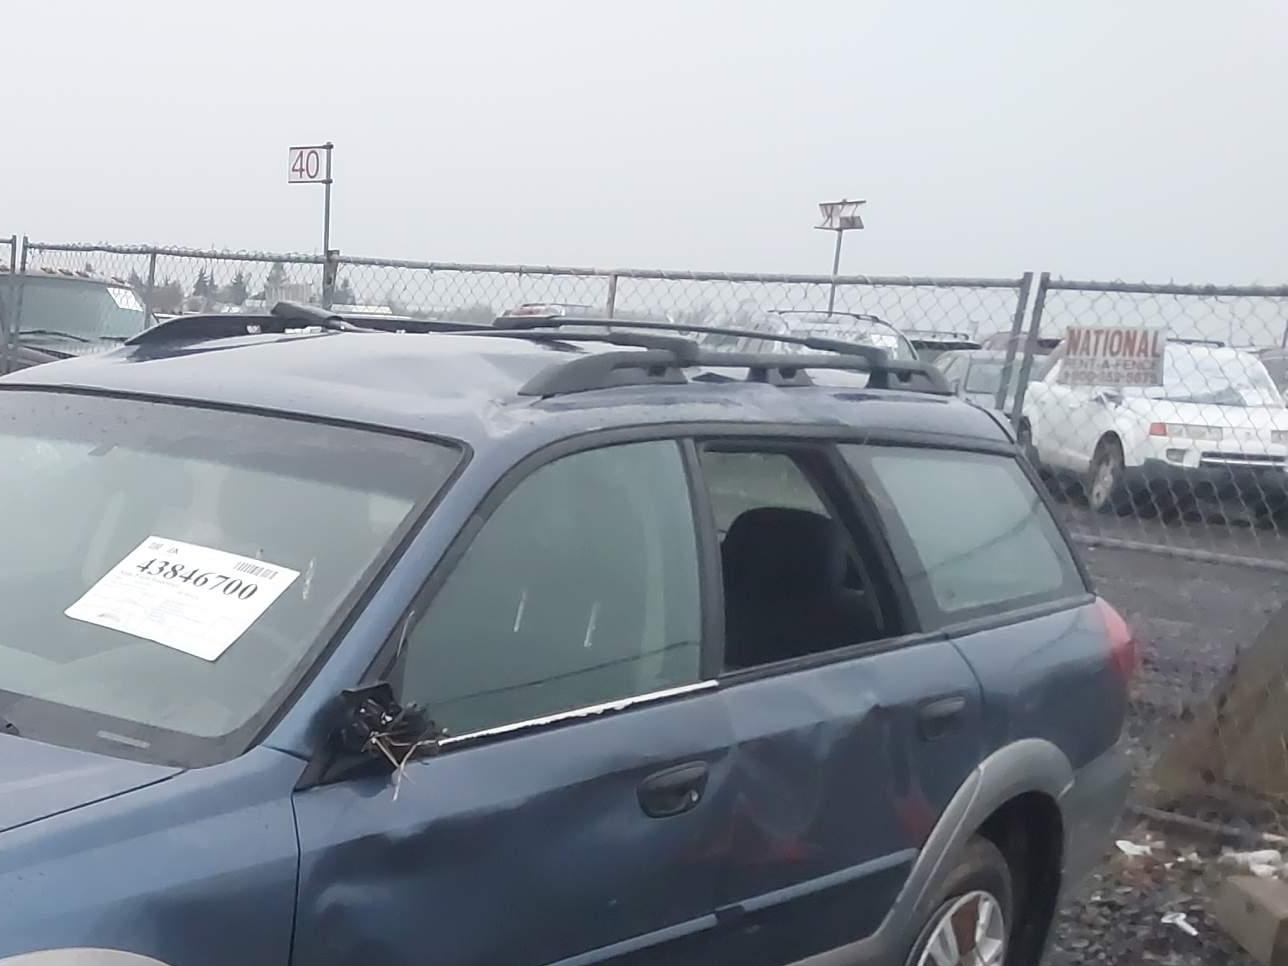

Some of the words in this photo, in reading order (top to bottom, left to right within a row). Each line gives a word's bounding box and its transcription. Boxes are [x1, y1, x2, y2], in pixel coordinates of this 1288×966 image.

[291, 150, 320, 179] 40
[1066, 328, 1161, 358] NATIONAL
[137, 557, 259, 601] 43846700
